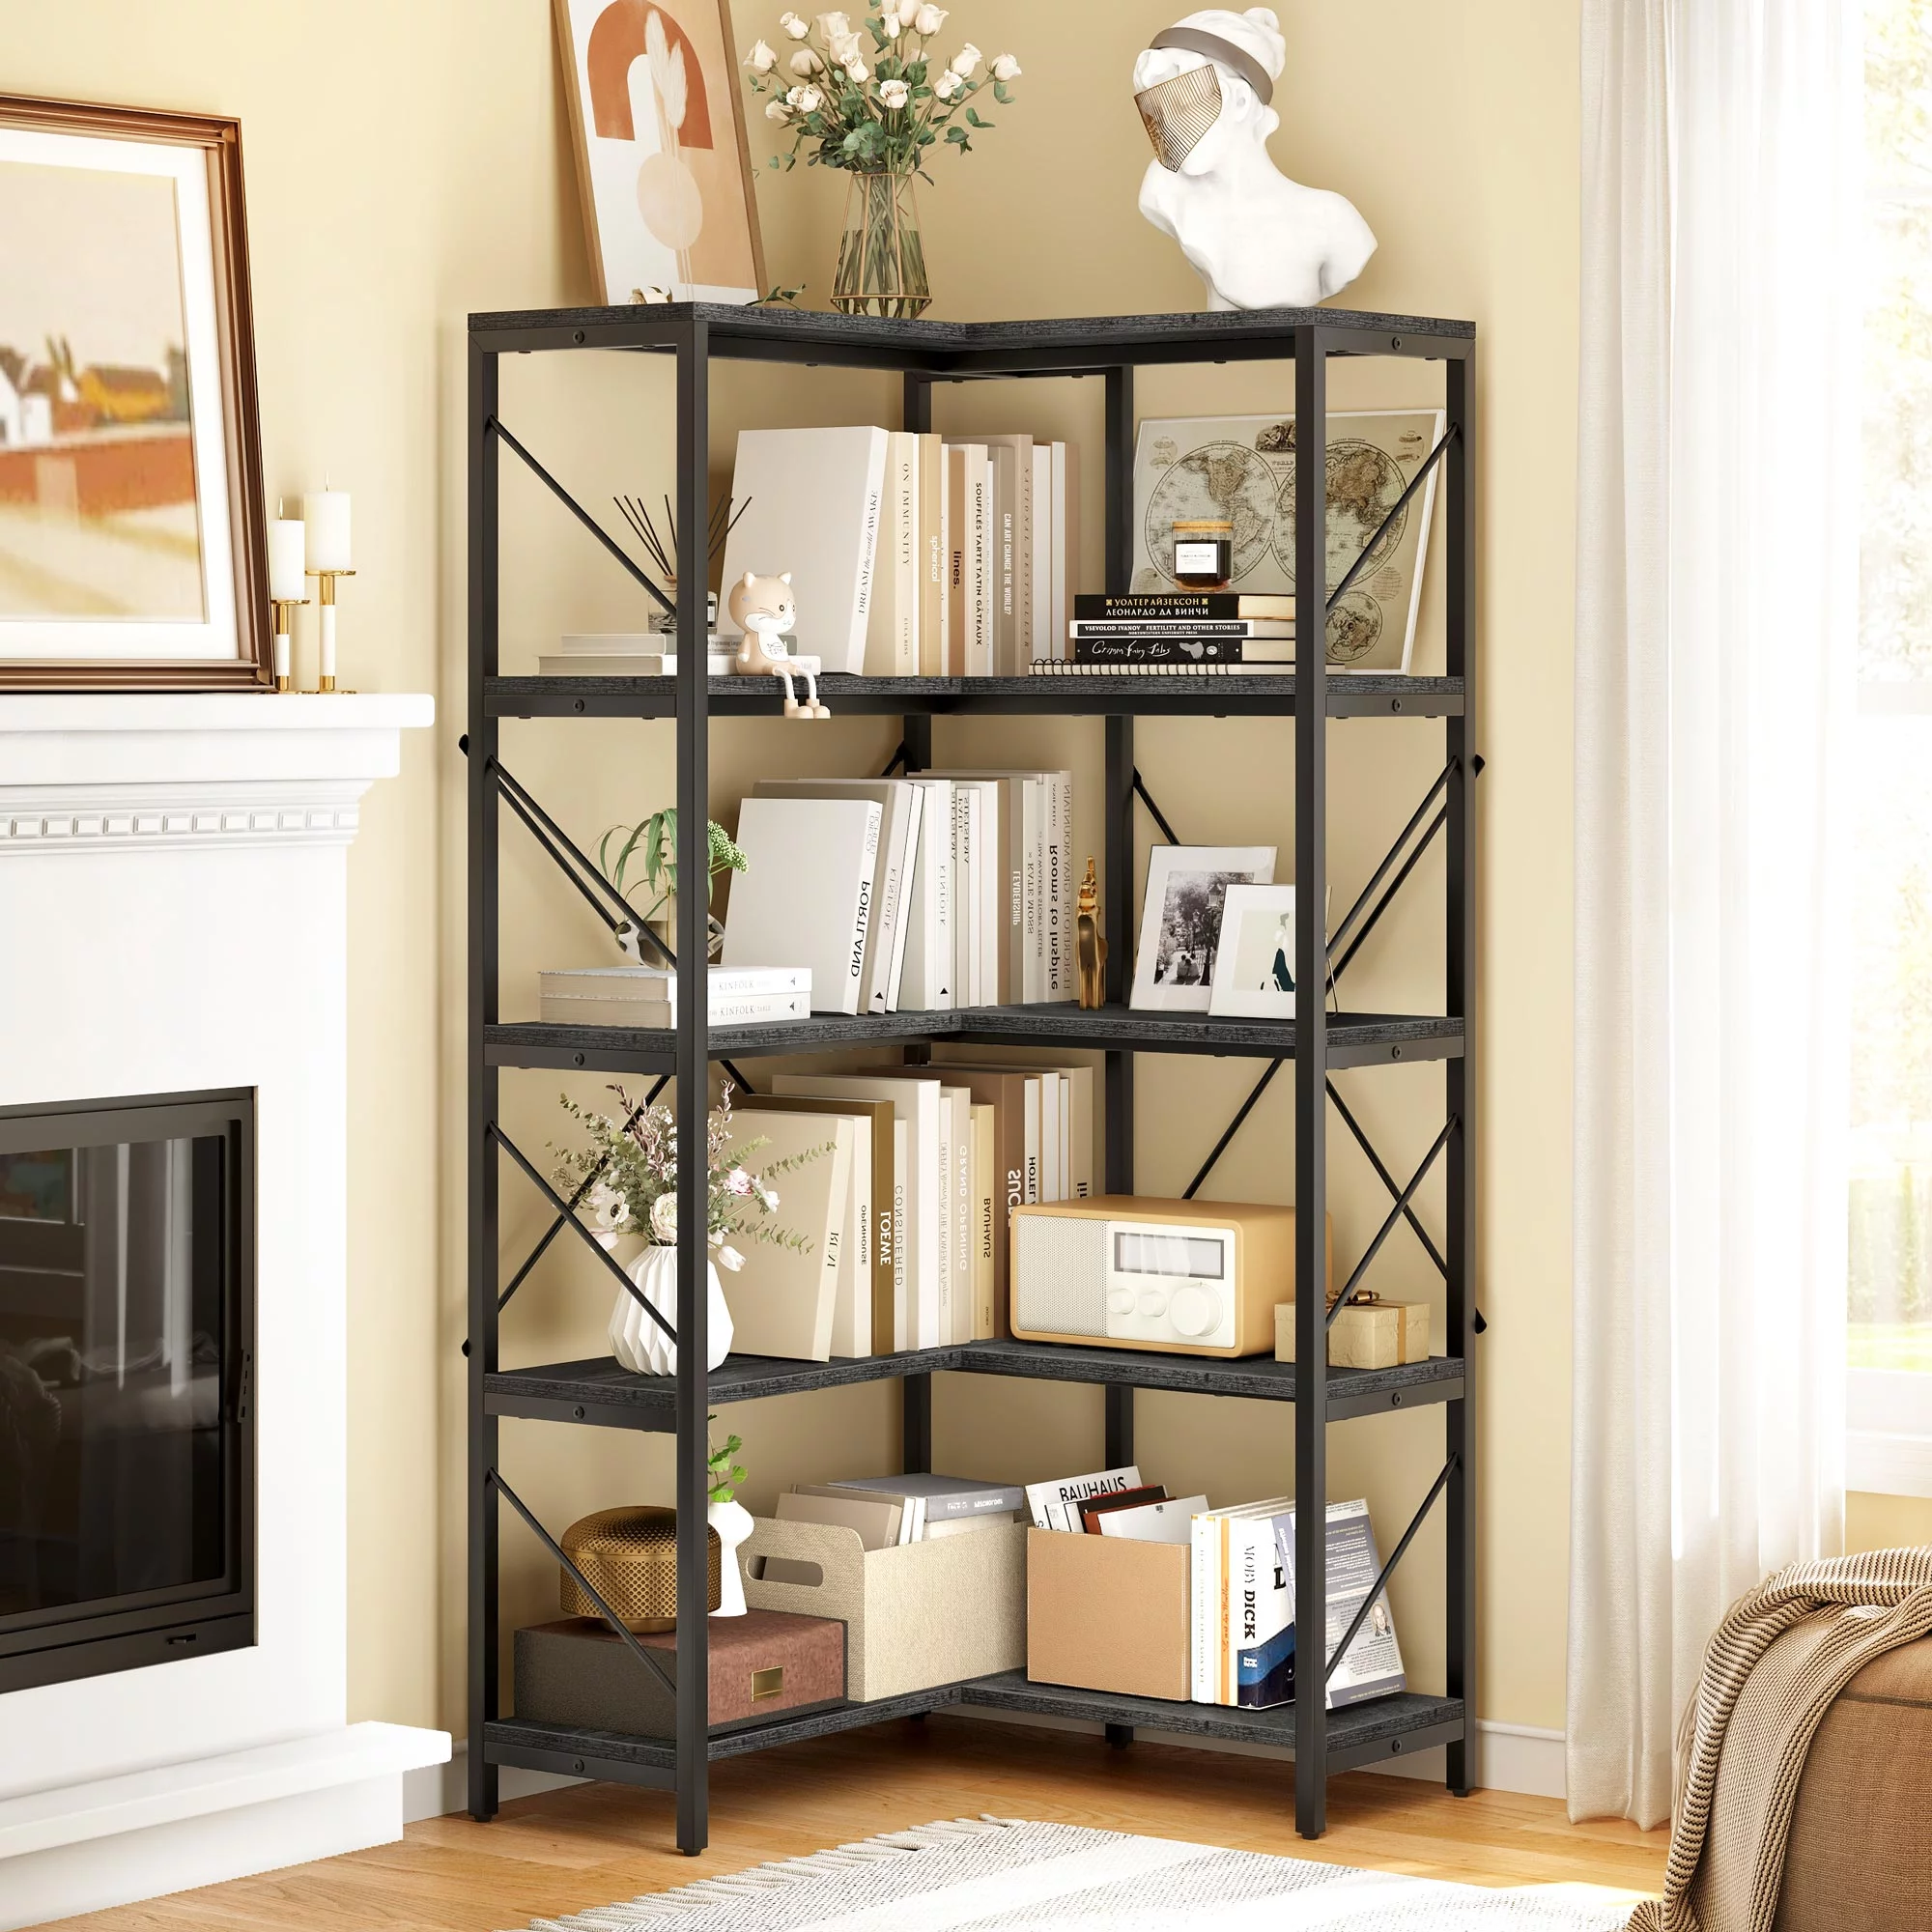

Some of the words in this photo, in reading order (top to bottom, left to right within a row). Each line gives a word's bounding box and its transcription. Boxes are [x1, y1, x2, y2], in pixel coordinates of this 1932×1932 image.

[902, 463, 909, 482] ON
[867, 490, 878, 531] AWAKE
[862, 556, 871, 570] the
[930, 535, 940, 582] spherical
[953, 551, 962, 589] lines.
[858, 570, 870, 614] DREAM
[1106, 608, 1156, 616] ЛЕОНАРДО
[1159, 608, 1171, 616] ДА
[1175, 607, 1208, 616] ВИНЧИ
[1092, 641, 1124, 655] Grimm
[1127, 640, 1145, 660] Fairy
[1147, 643, 1171, 657] Tales
[719, 980, 755, 991] KINFOLK
[720, 1005, 755, 1017] KINFOLK
[1059, 1477, 1127, 1502] BAUHAUS
[1244, 1546, 1255, 1584] MOBY
[1244, 1590, 1255, 1639] DICK
